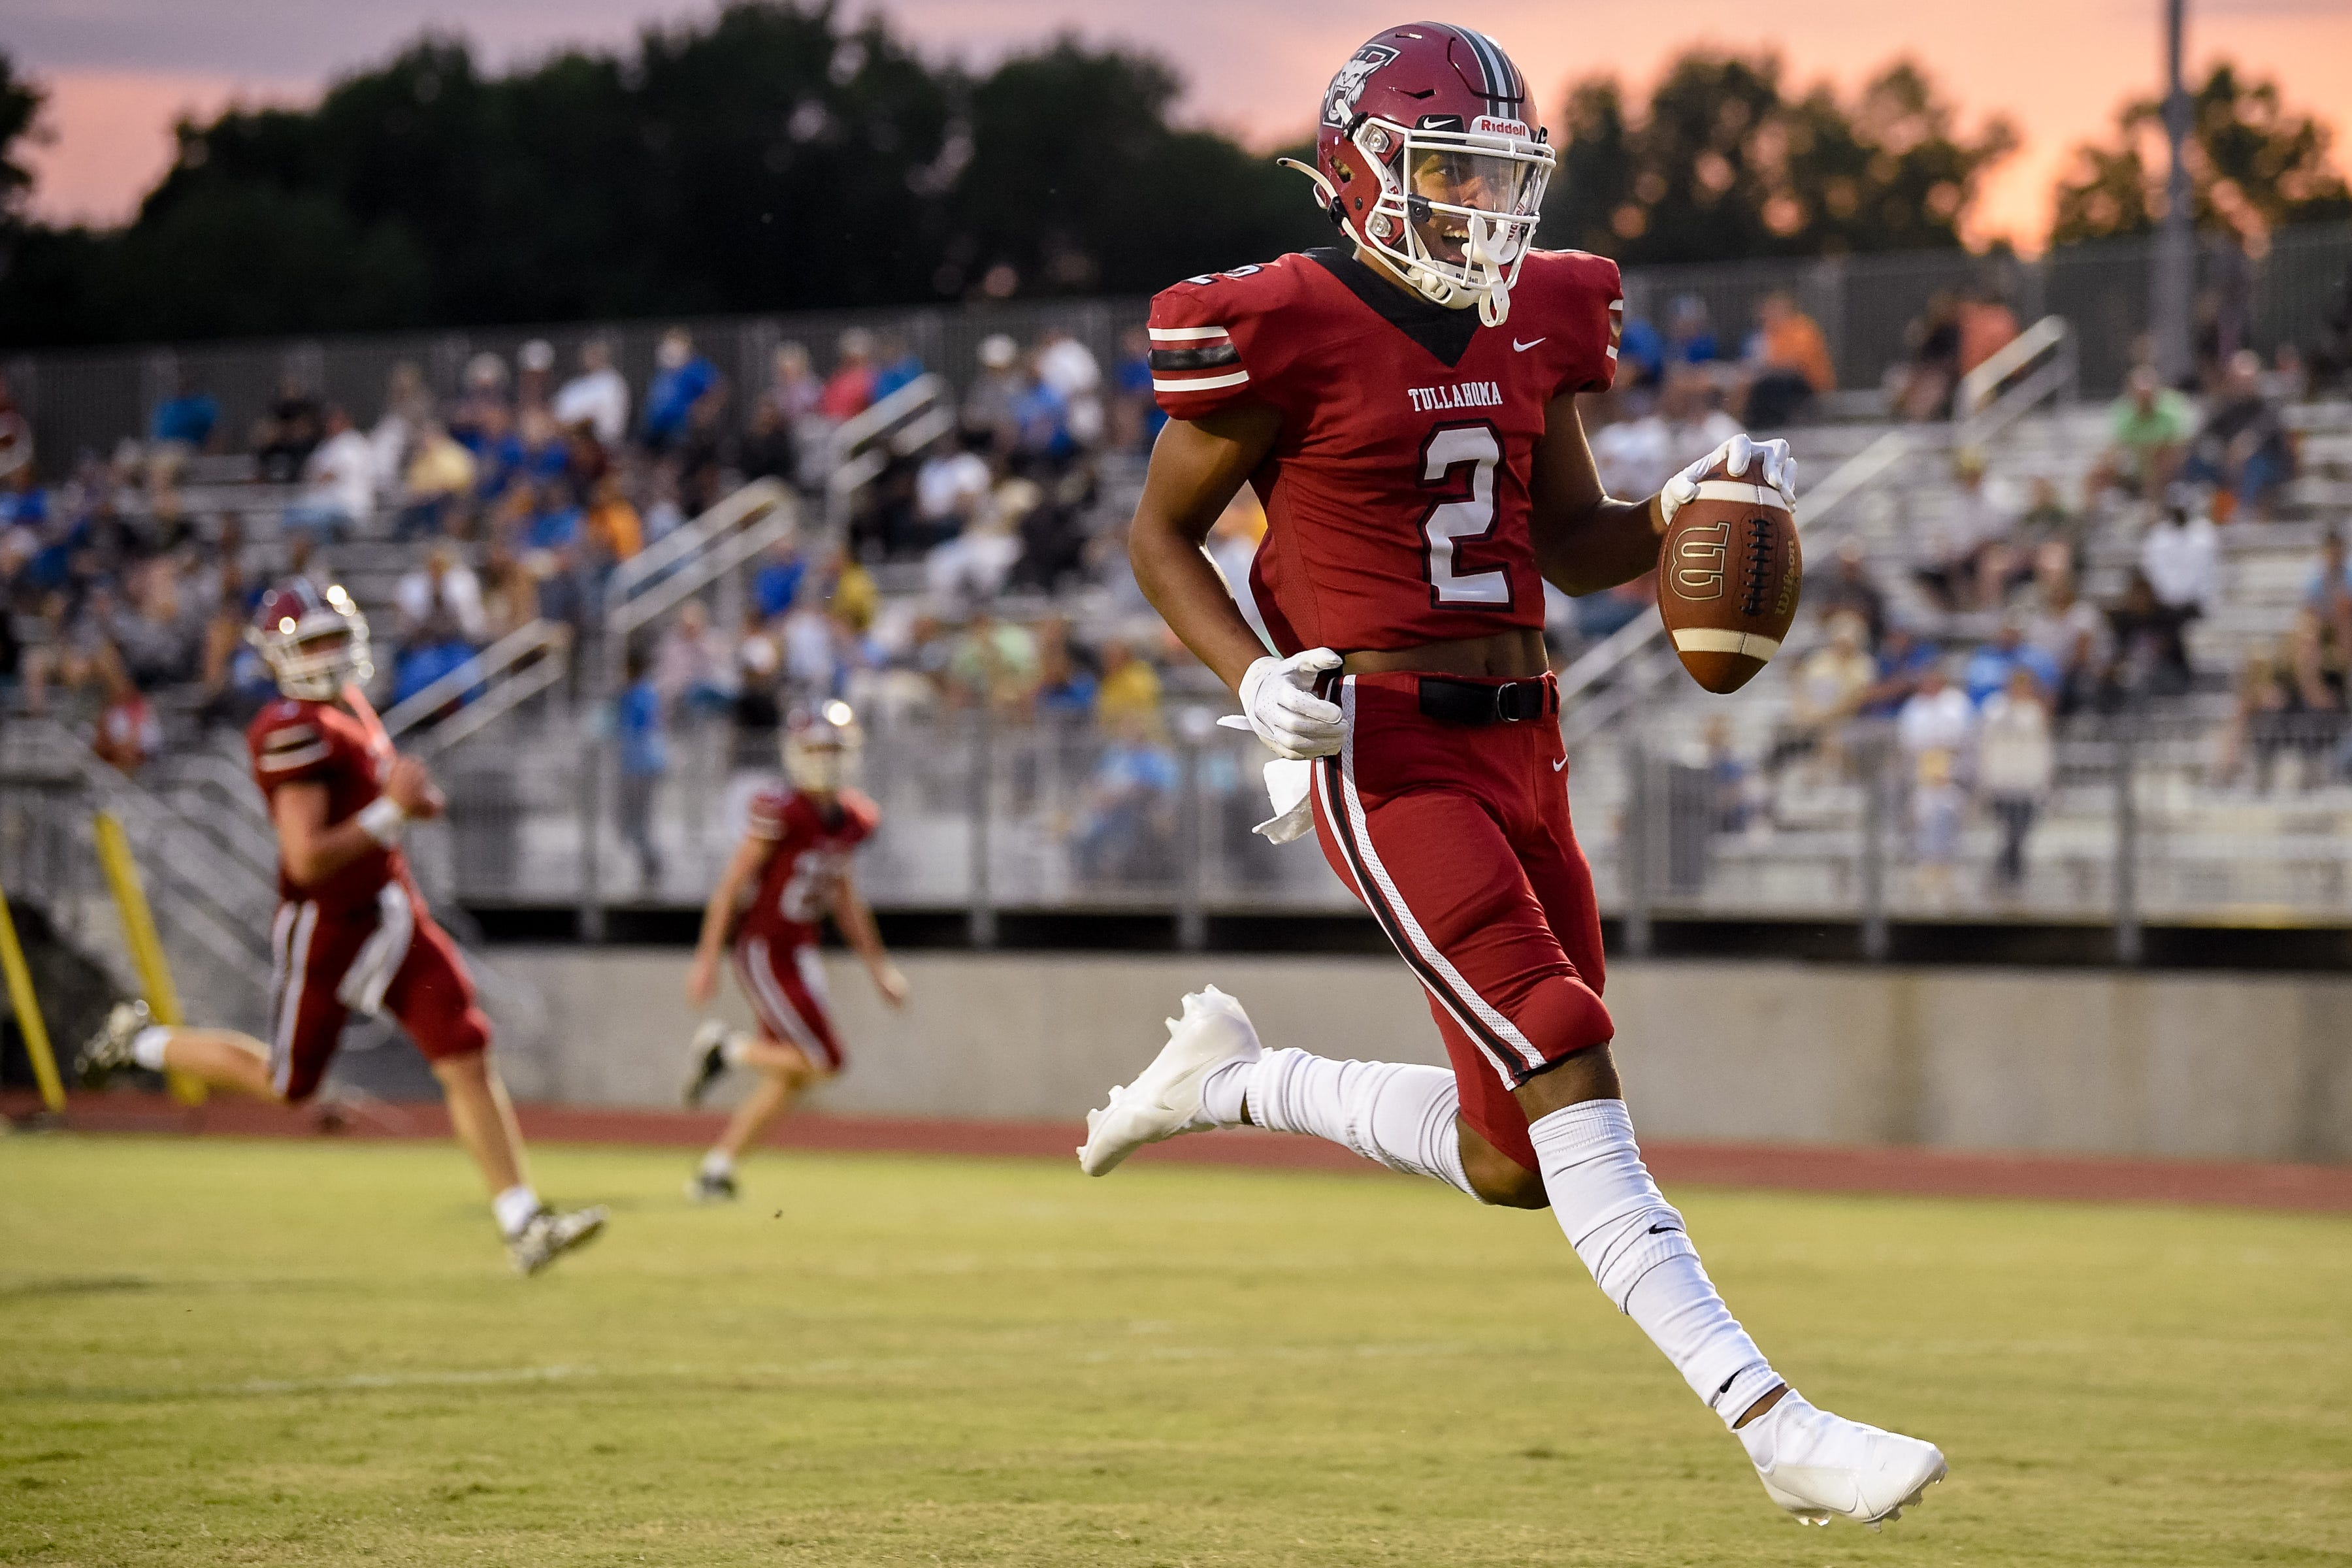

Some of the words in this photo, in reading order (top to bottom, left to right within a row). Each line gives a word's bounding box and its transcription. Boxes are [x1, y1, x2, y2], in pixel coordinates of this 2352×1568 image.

[1481, 119, 1526, 136] Riddell
[1507, 202, 1525, 241] idell
[1456, 273, 1478, 284] Ridell
[1407, 382, 1503, 412] TULLAHOMA
[1416, 418, 1514, 612] 2
[1774, 540, 1795, 615] Wilson
